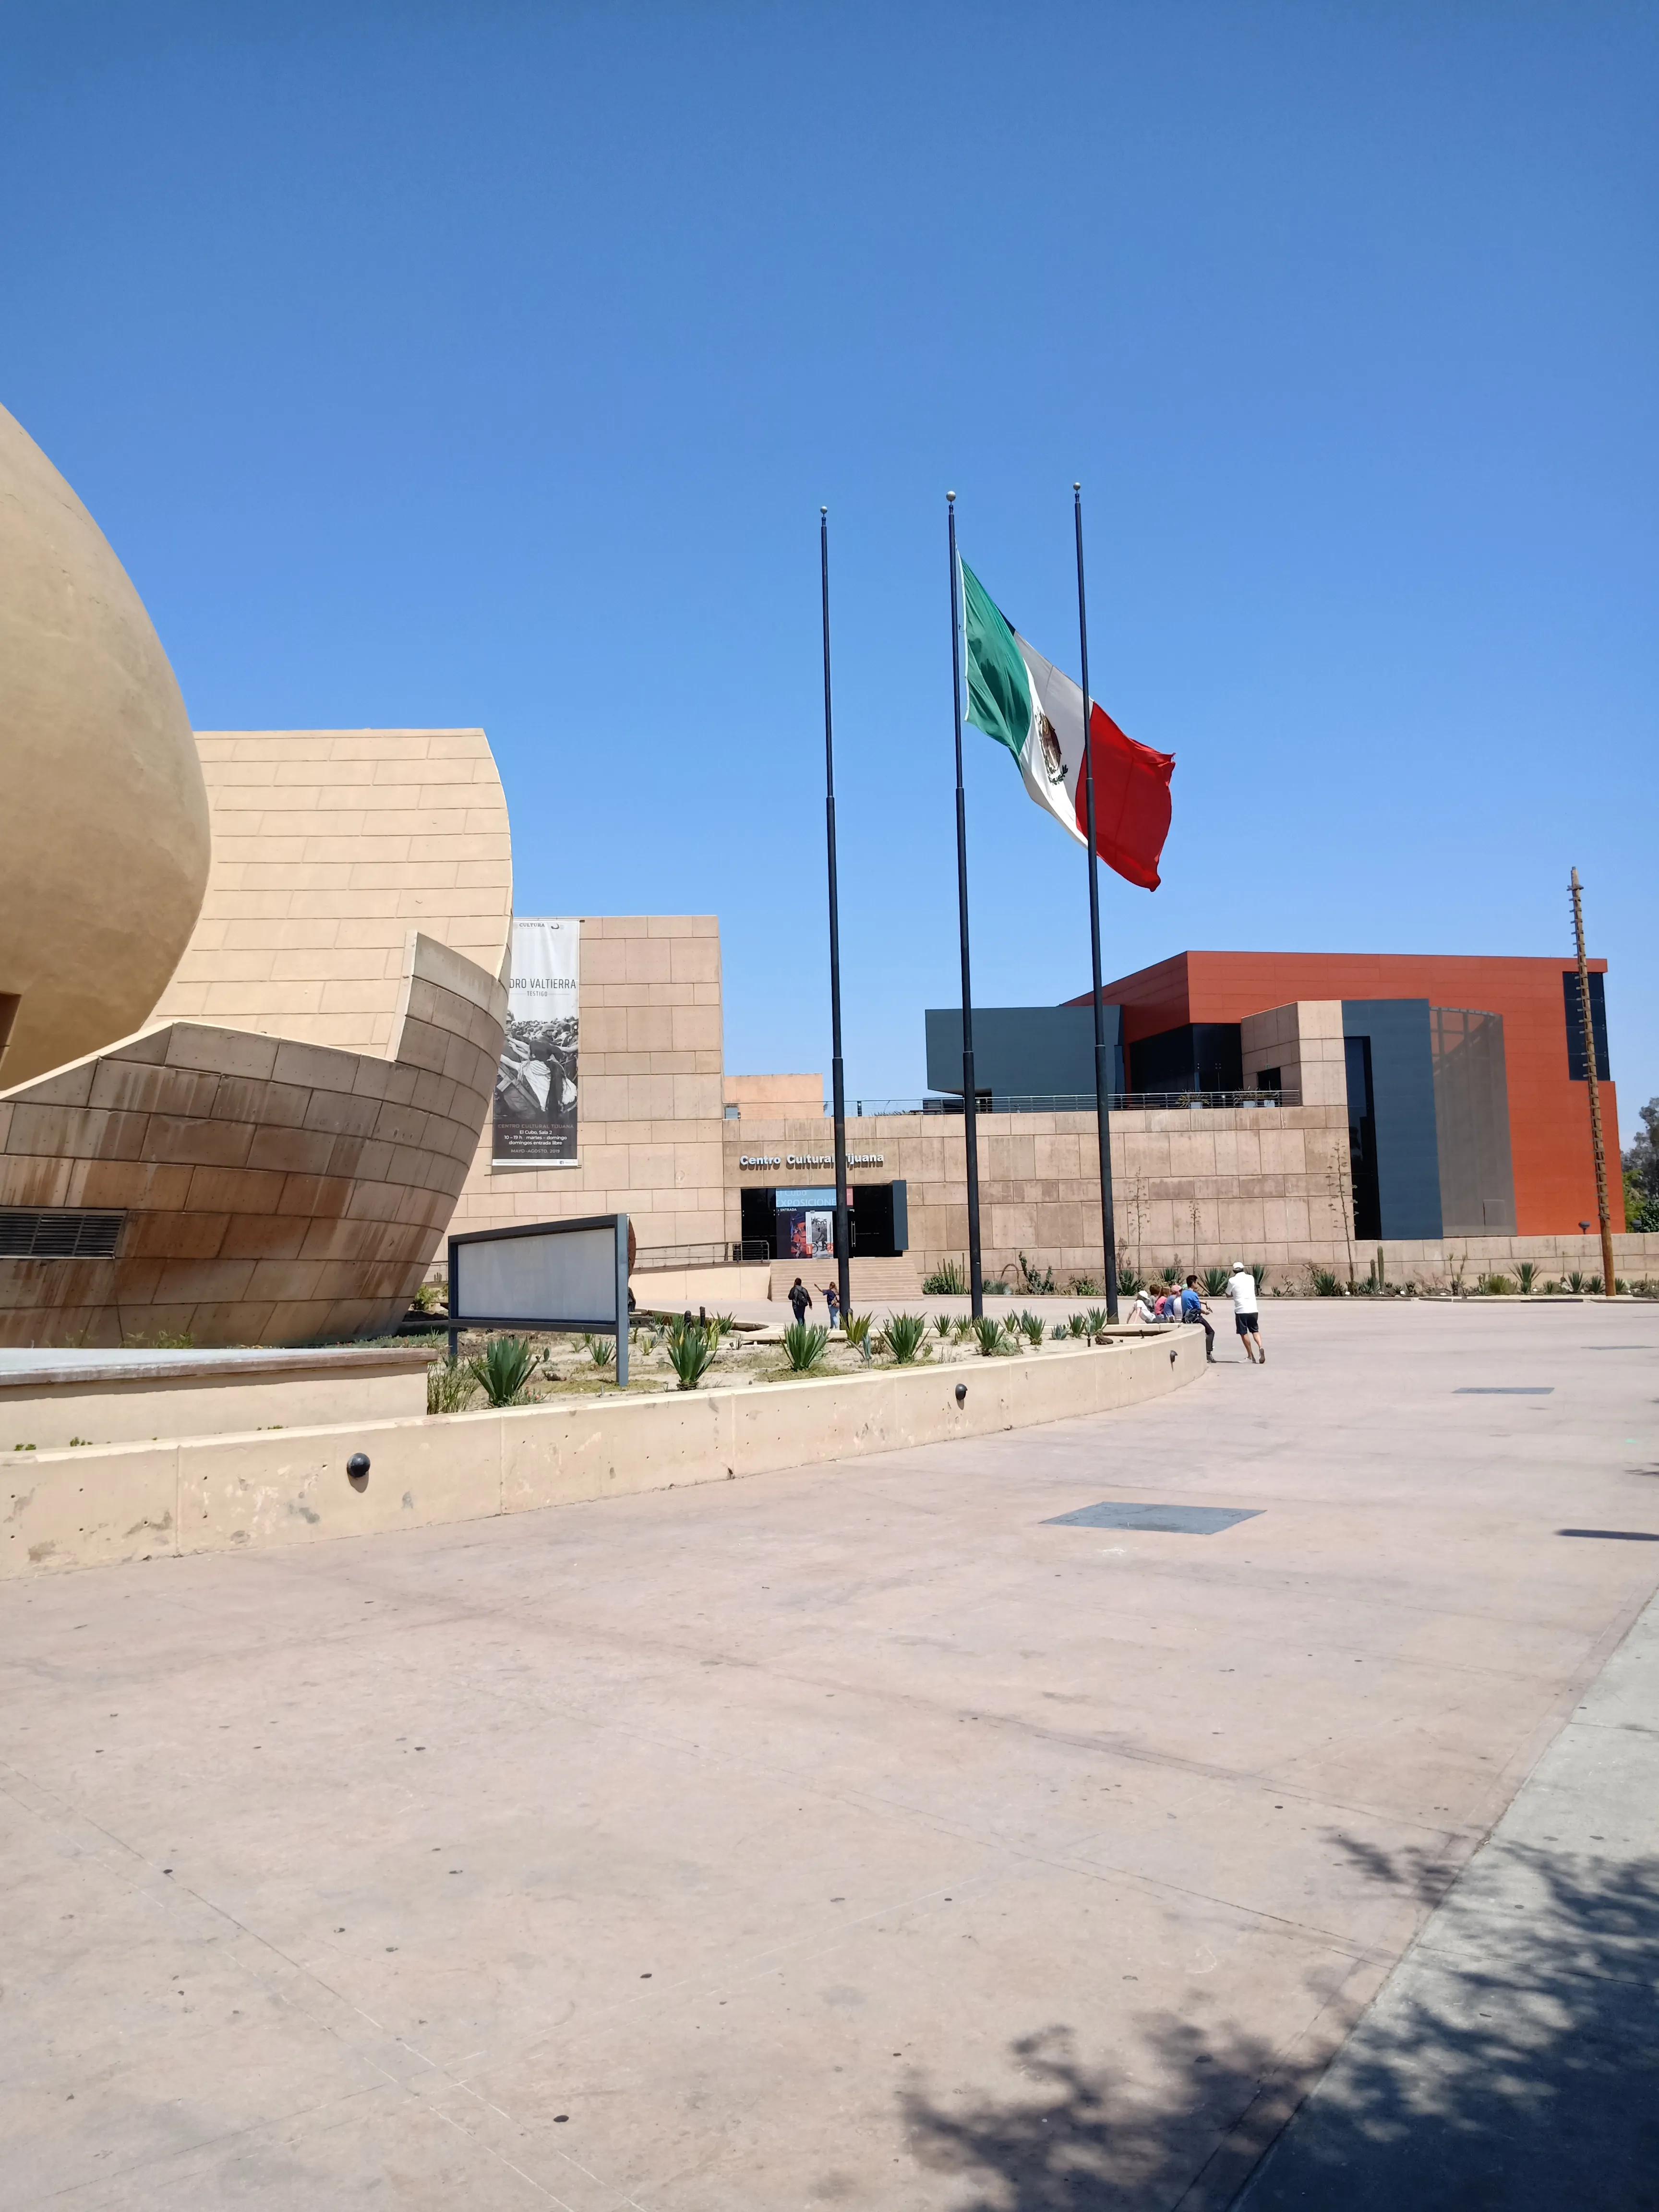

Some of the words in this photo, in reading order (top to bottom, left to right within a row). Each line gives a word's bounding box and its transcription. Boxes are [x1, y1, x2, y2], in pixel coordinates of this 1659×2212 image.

[510, 979, 527, 988] DRO
[530, 979, 576, 989] VALTIERRA
[740, 1155, 781, 1165] Centro
[786, 1154, 835, 1164] Cultural
[776, 1198, 837, 1207] EXPOSICIONE
